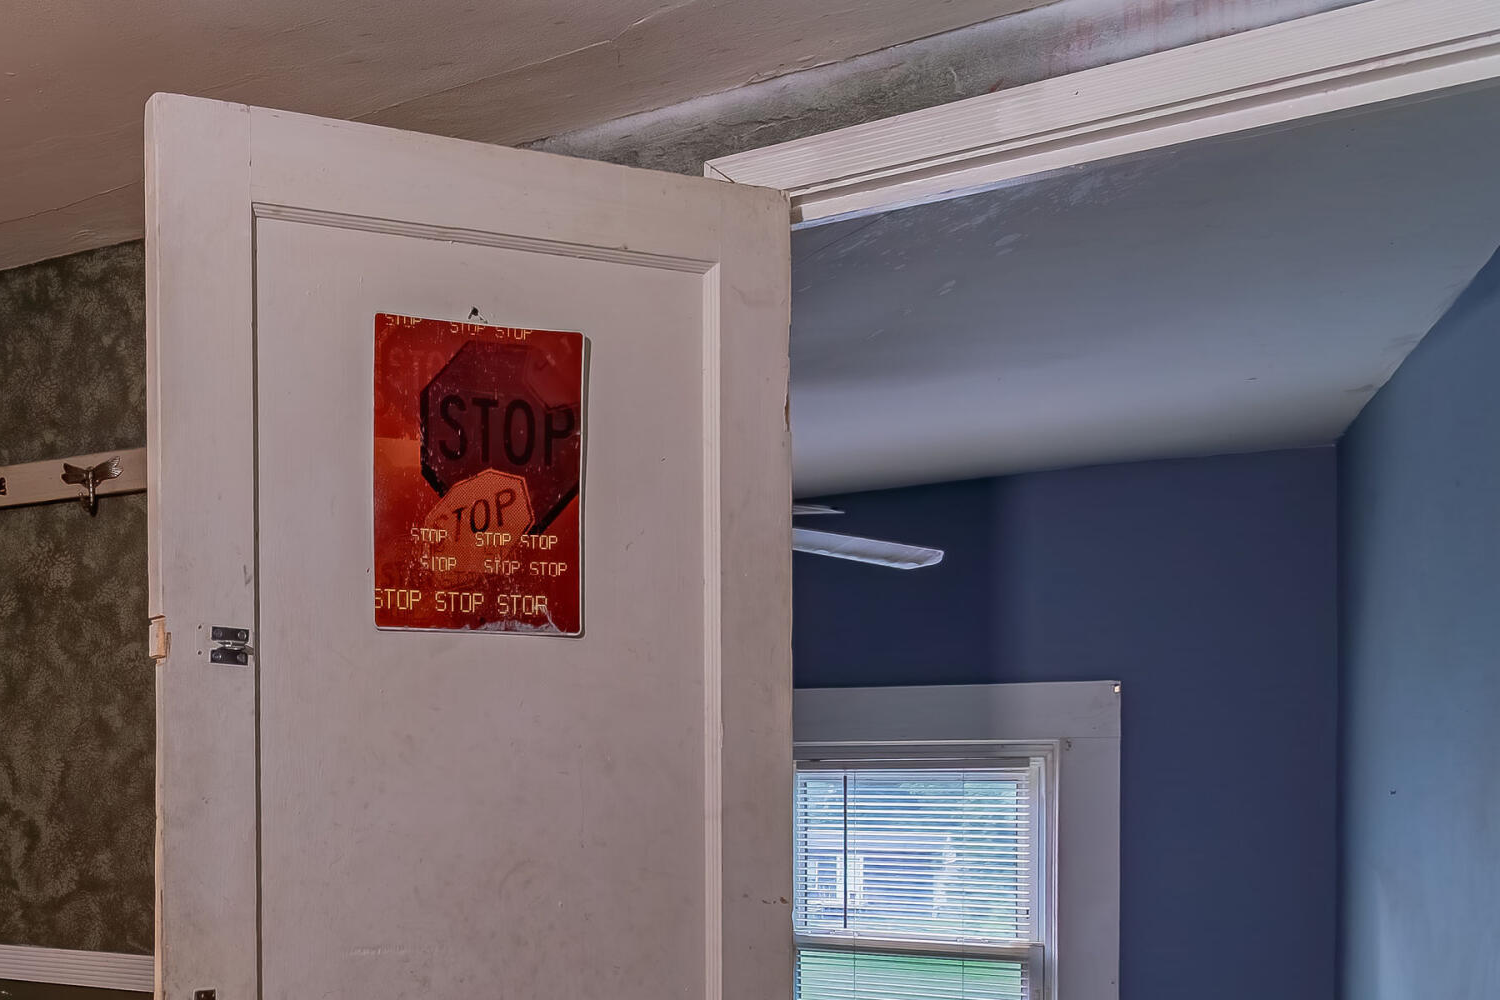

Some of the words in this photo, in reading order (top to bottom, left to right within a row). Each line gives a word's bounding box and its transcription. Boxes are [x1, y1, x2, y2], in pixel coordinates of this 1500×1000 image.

[438, 394, 575, 466] STOP
[475, 532, 512, 547] STOP
[521, 535, 558, 550] STOP
[420, 557, 457, 572] STOP
[484, 560, 521, 576] STOP
[530, 561, 568, 577] STOP
[375, 588, 422, 610] STOP
[435, 591, 484, 613] STOP
